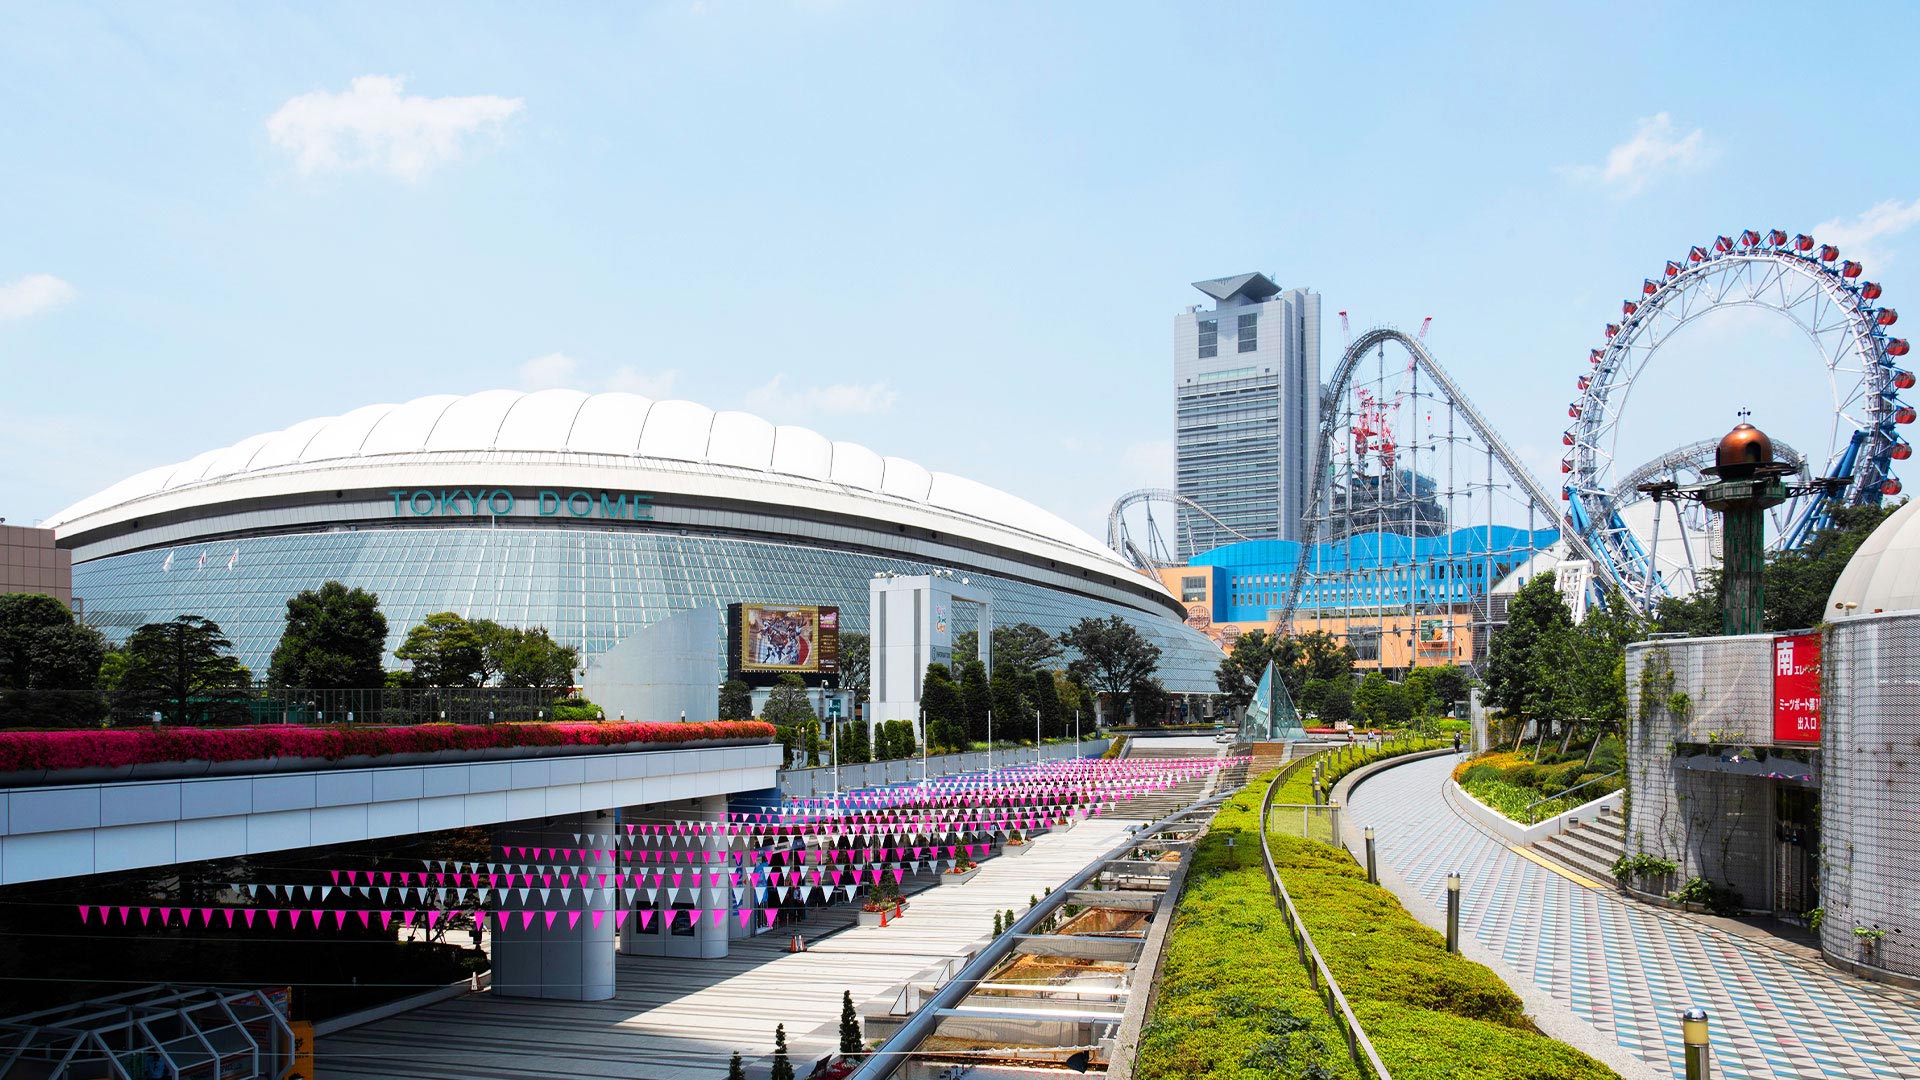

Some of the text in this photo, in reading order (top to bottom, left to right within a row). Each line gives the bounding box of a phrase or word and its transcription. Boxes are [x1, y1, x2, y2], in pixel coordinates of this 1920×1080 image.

[388, 488, 655, 520] TOKYO DOME
[1776, 640, 1794, 676] 南
[1779, 697, 1821, 711] ミーツポート第1
[1797, 716, 1817, 730] 出入口
